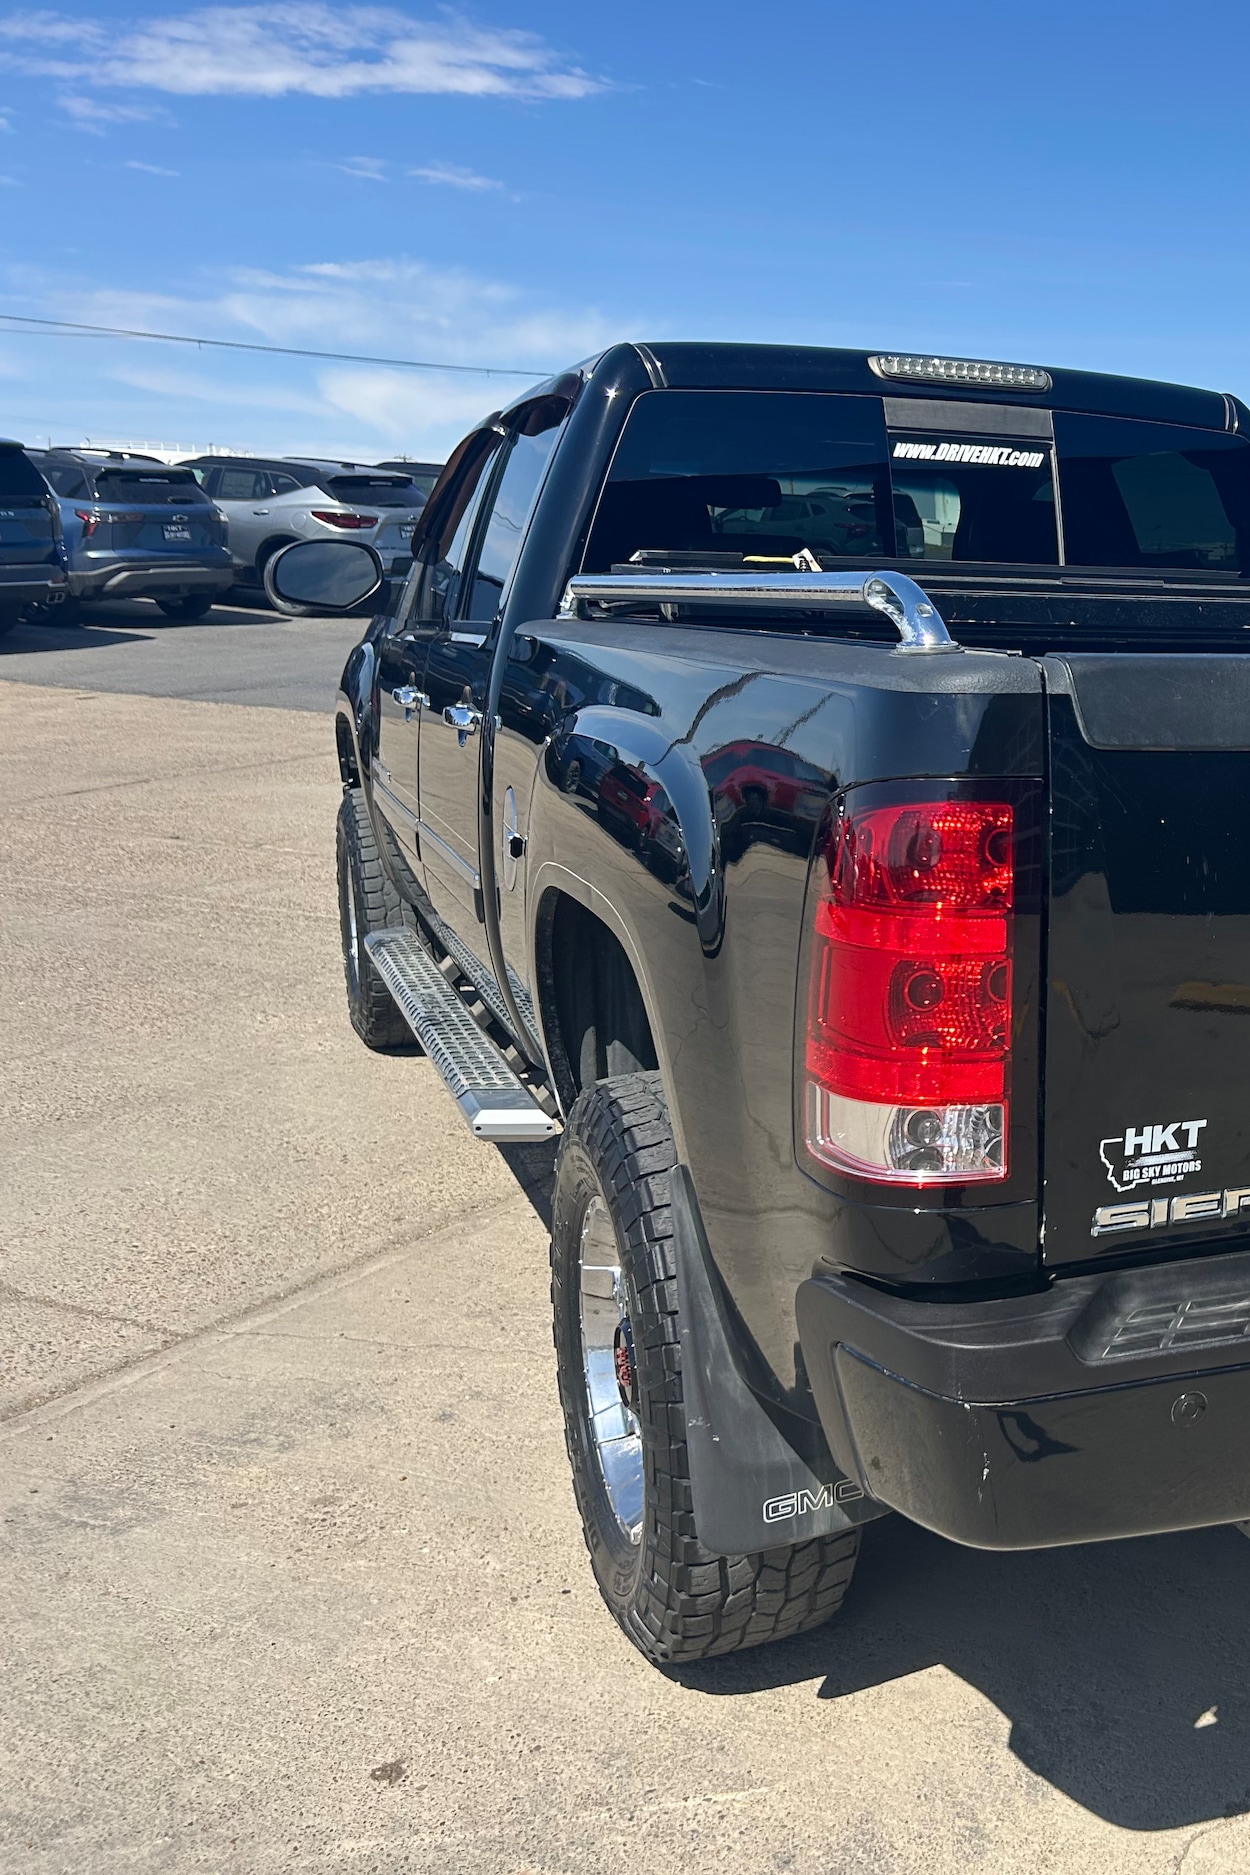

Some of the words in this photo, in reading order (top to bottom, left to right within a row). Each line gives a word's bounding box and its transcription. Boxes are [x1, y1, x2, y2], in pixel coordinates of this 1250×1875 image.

[893, 443, 1045, 468] www.DRIVEHKT.com
[1124, 1119, 1207, 1156] HKT
[1123, 1169, 1141, 1181] BIG
[1141, 1165, 1162, 1178] SKY
[1162, 1160, 1202, 1176] MOTORS
[763, 1478, 865, 1523] GMC
